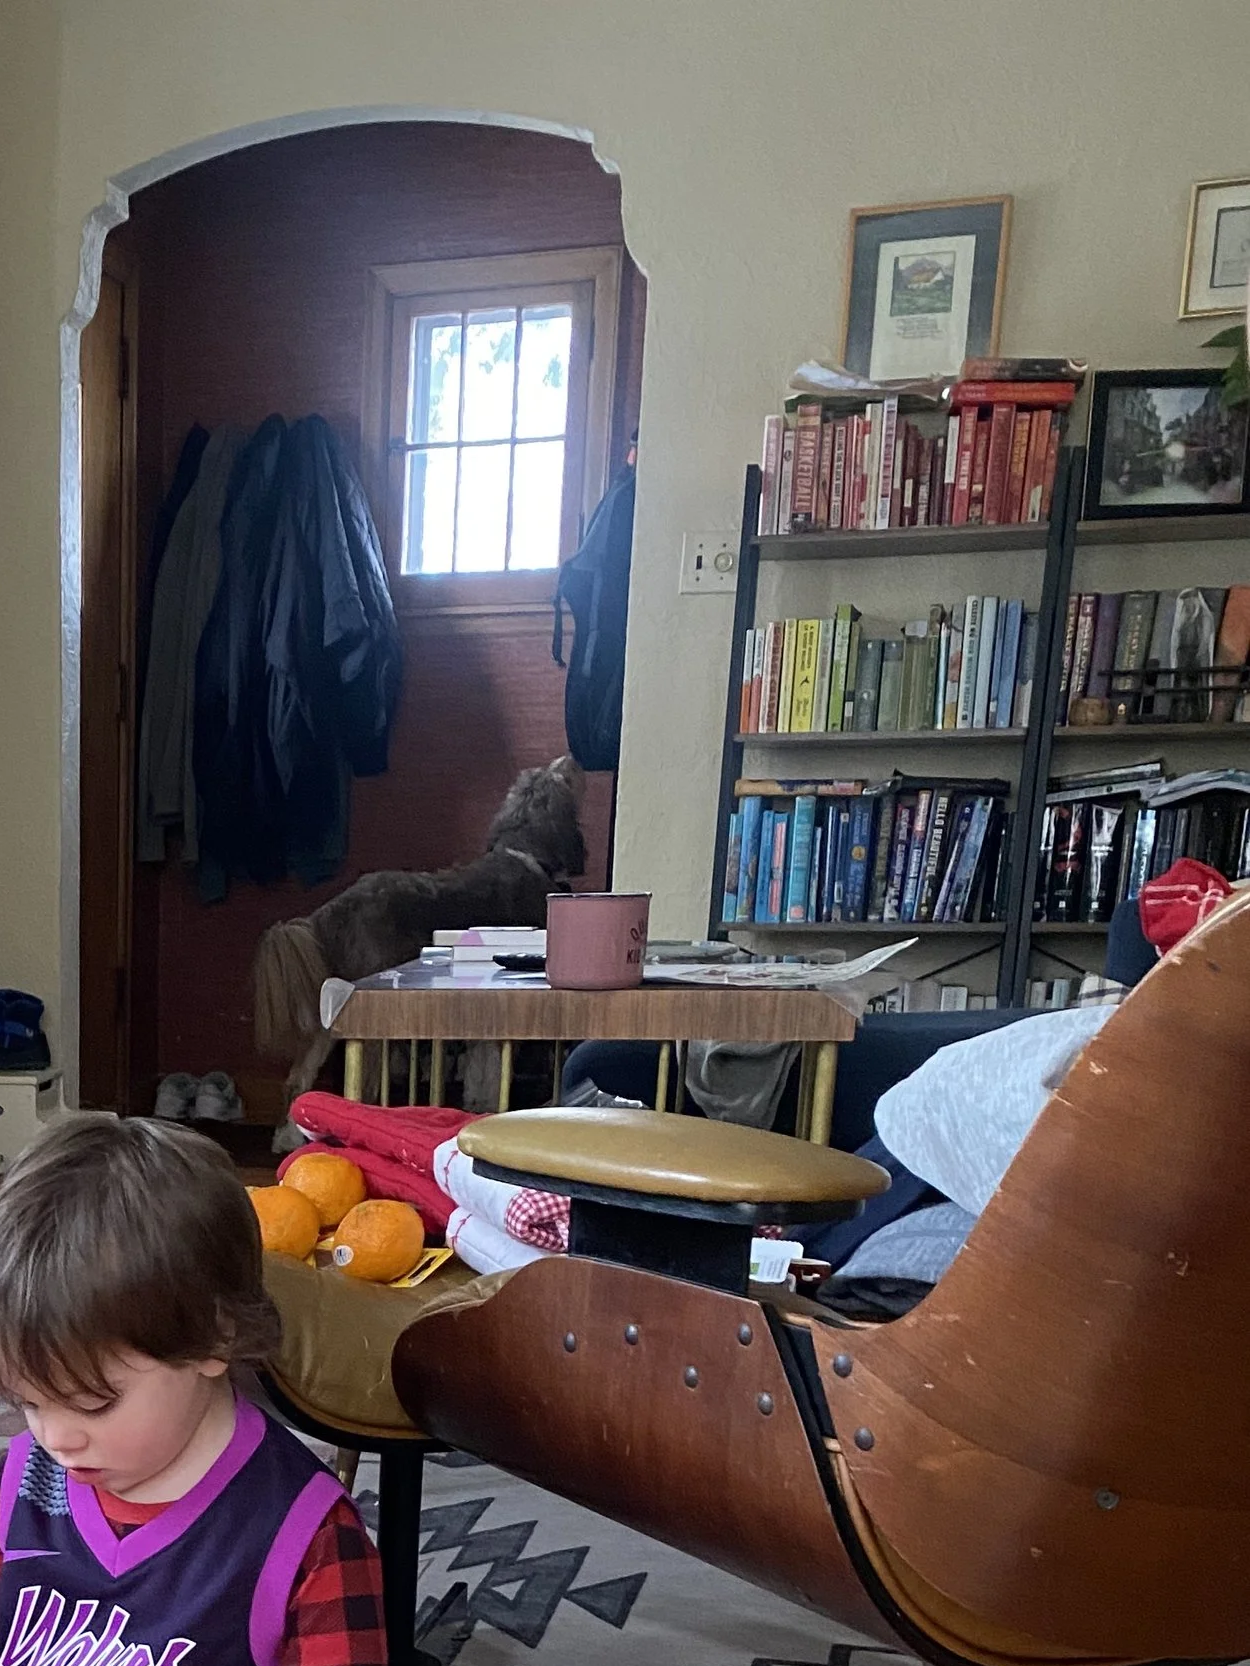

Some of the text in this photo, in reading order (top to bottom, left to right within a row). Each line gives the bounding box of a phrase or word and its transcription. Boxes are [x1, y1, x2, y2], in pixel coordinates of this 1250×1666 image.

[796, 431, 816, 509] BASKETBALL
[935, 796, 949, 825] HELLO
[926, 828, 943, 878] BEAUTIFUL
